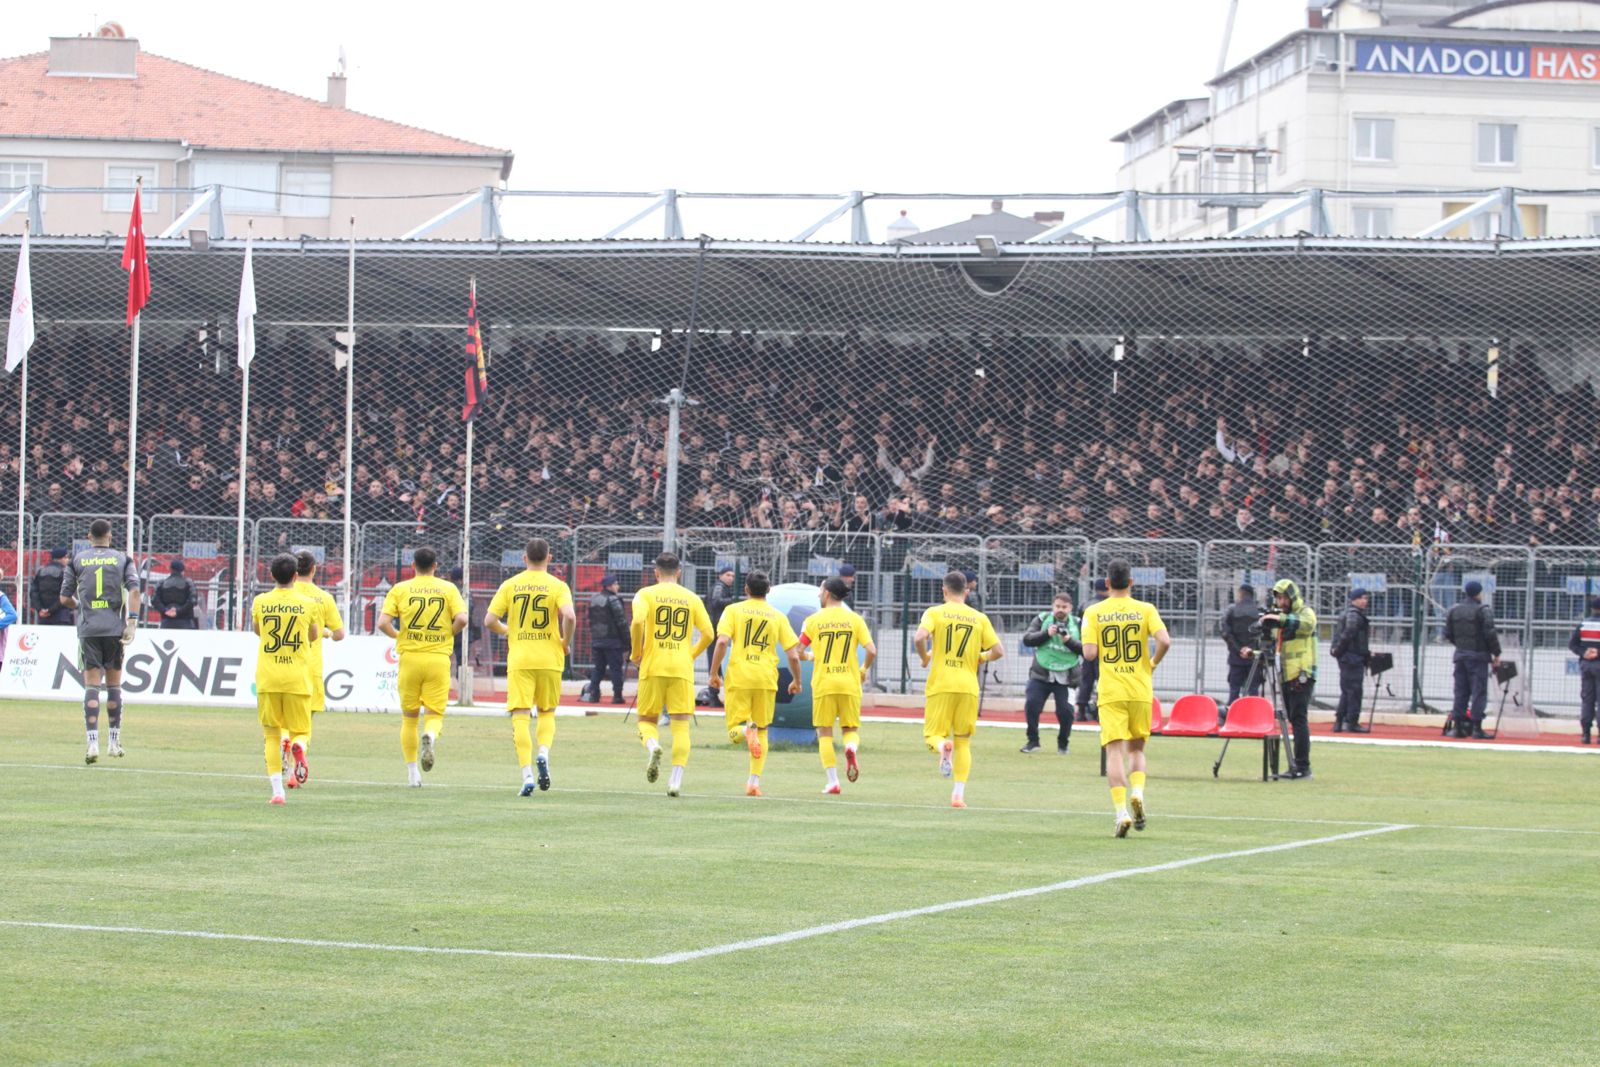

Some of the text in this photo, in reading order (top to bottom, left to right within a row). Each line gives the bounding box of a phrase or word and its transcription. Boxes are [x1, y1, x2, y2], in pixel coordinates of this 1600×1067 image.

[1366, 44, 1600, 79] ANADOLU HAS
[81, 557, 118, 566] turknet
[94, 566, 103, 599] 1
[514, 584, 549, 592] turknet
[91, 600, 109, 609] BORA
[262, 603, 305, 614] turknet
[408, 597, 445, 630] 22
[513, 594, 550, 629] 75
[943, 612, 977, 624] turknet
[1097, 611, 1143, 622] turknet
[263, 615, 303, 653] 34
[654, 605, 689, 641] 99
[743, 618, 770, 652] 14
[819, 631, 853, 664] 77
[945, 623, 973, 657] 17
[1102, 624, 1142, 663] 96
[52, 639, 242, 697] NSİNE
[274, 655, 293, 664] TAHA
